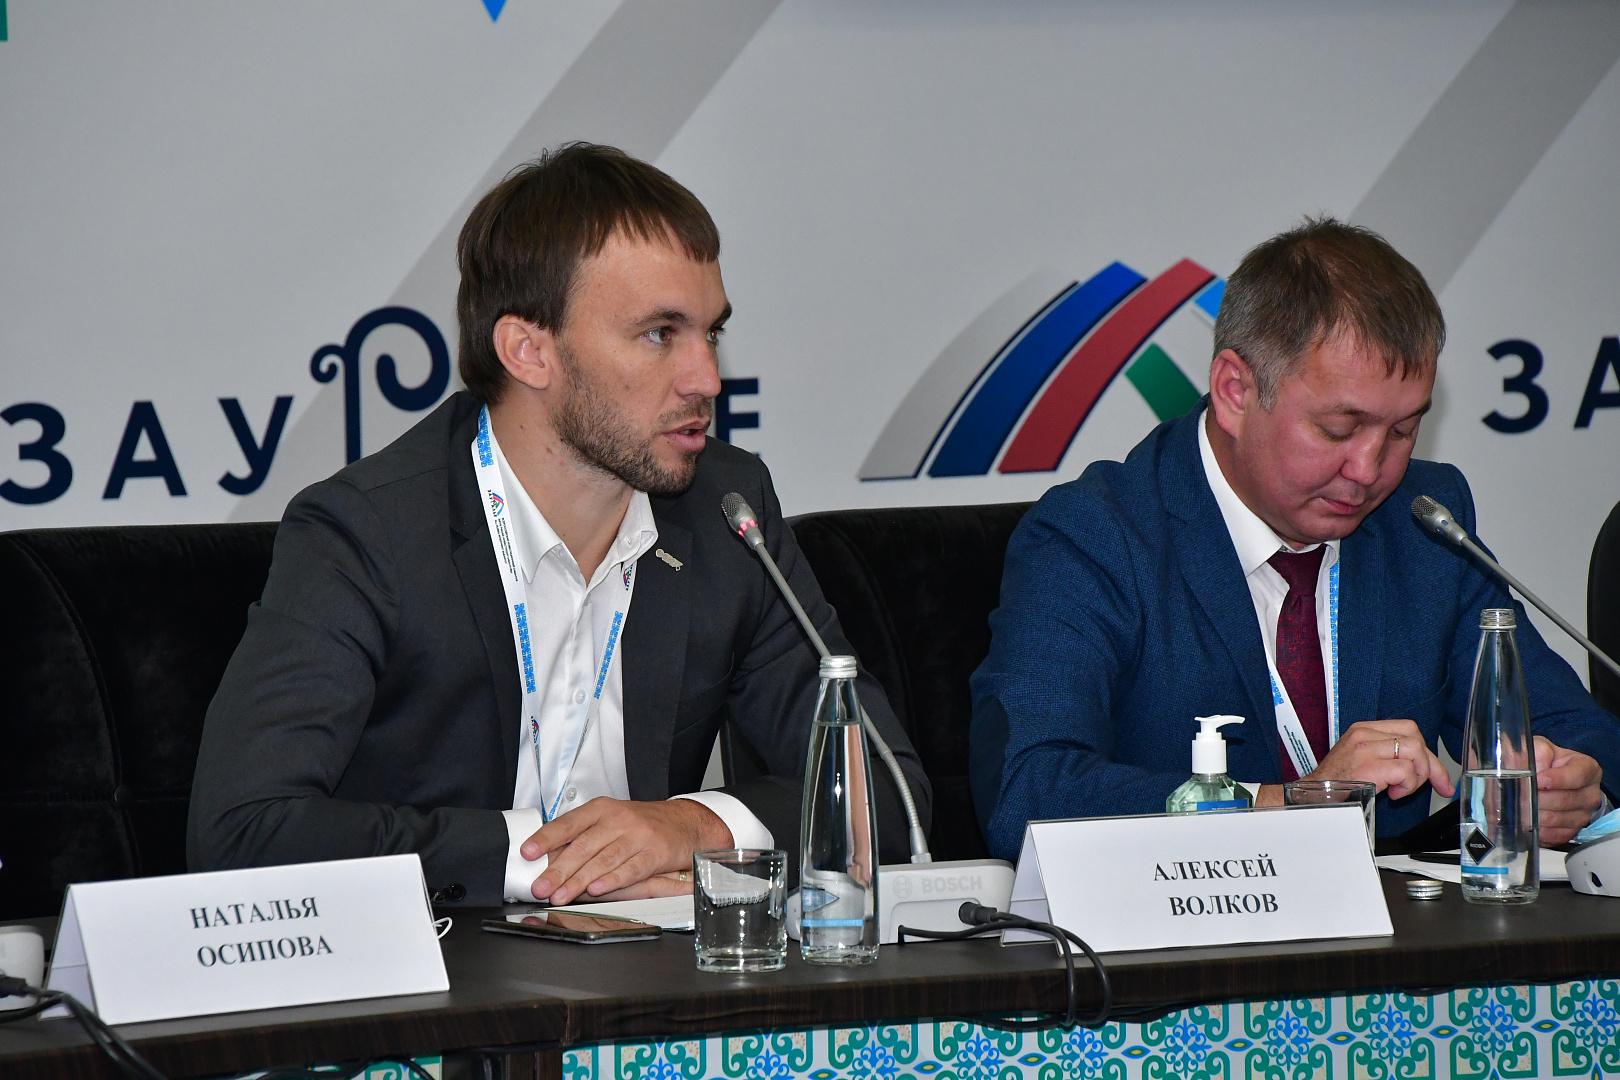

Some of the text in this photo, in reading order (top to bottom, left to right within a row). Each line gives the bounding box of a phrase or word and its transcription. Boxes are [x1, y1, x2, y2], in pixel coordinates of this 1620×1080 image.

[1153, 853, 1279, 881] АЛЕКСЕЙ
[921, 875, 983, 894] BOSCH
[189, 896, 320, 930] НАТАЛЬЯ
[1168, 893, 1279, 917] ВОЛКОВ
[196, 934, 334, 968] ОСИПОВА
